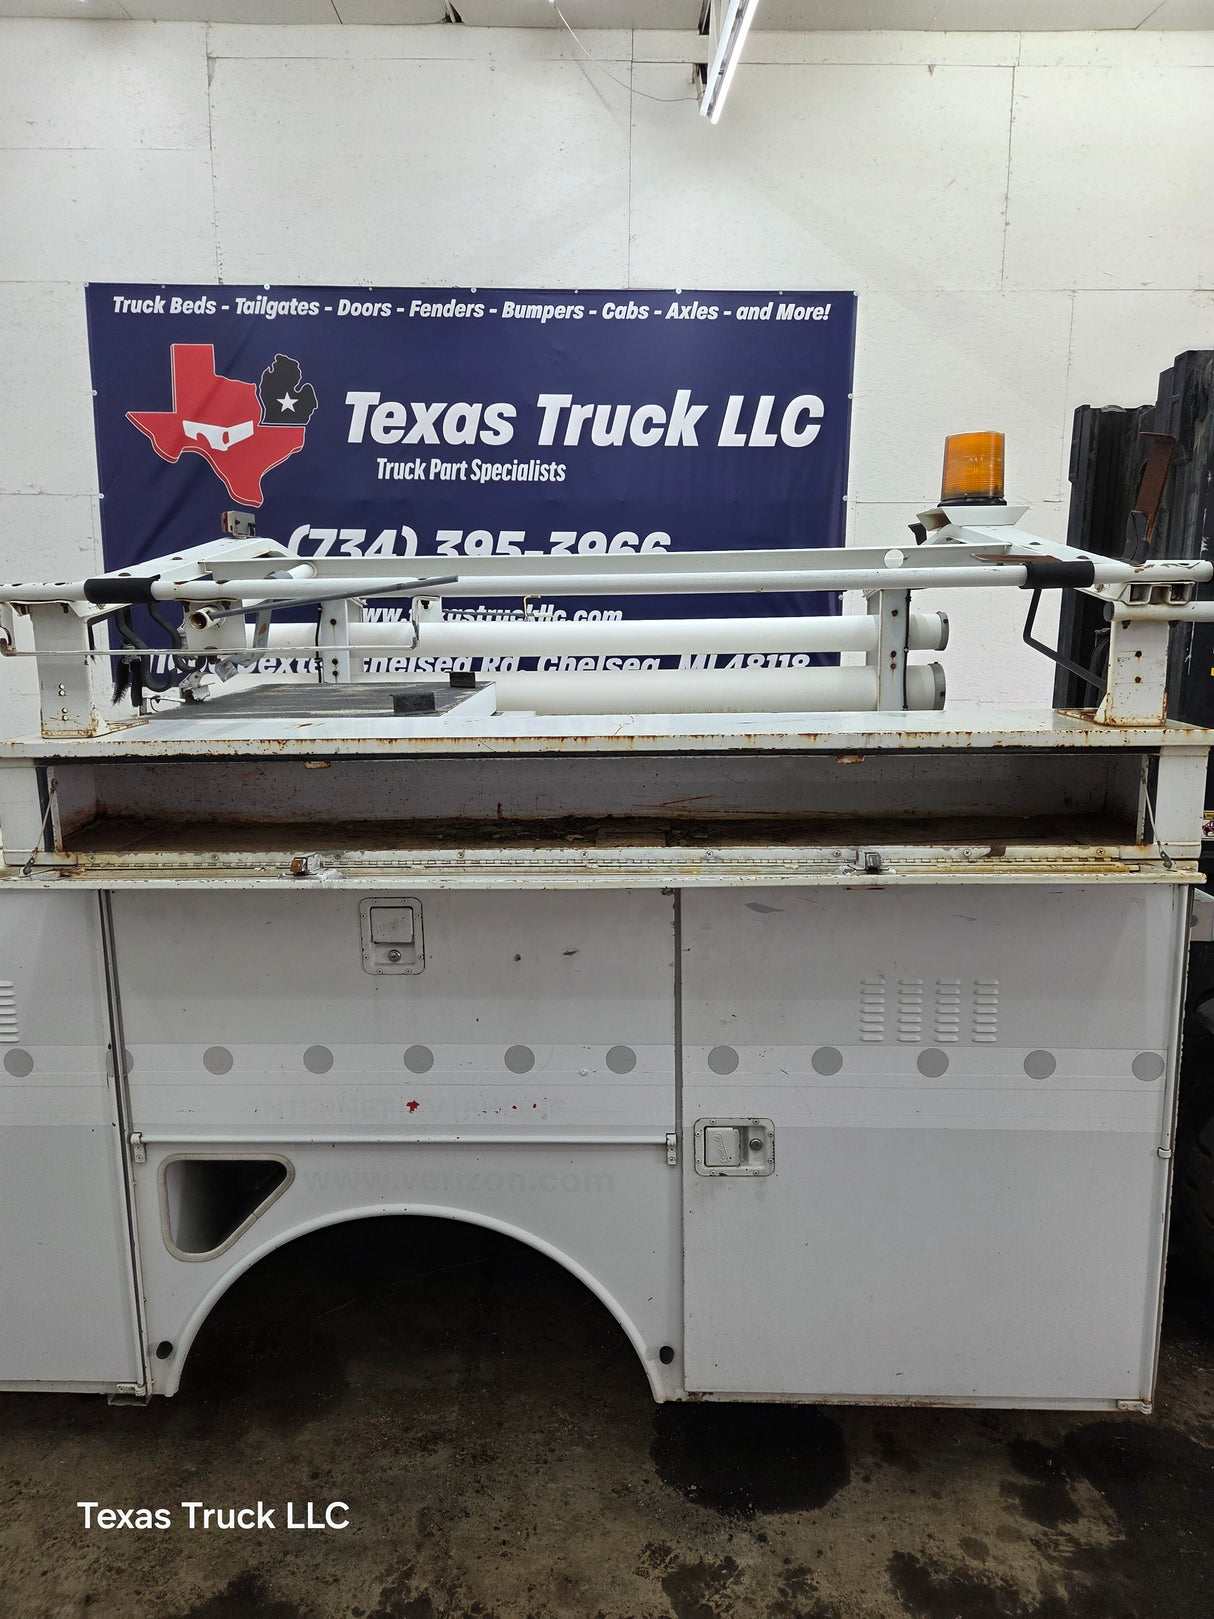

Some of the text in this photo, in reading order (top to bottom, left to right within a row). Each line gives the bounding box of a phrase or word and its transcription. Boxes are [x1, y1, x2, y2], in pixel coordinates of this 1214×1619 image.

[113, 296, 166, 314] Truck
[169, 296, 217, 315] Beds
[235, 295, 320, 320] Tailgates
[337, 299, 393, 317] Doors
[408, 299, 485, 318] Fenders
[501, 301, 585, 323] Bumpers
[601, 301, 650, 320] Cabs
[664, 301, 720, 320] Axles
[735, 302, 774, 321] and
[775, 303, 832, 321] More!
[344, 389, 825, 448] Texas Truck LLC
[376, 458, 567, 484] Truck Part Specialists
[287, 524, 672, 557] (734) 395-3966
[363, 657, 473, 673] helsea
